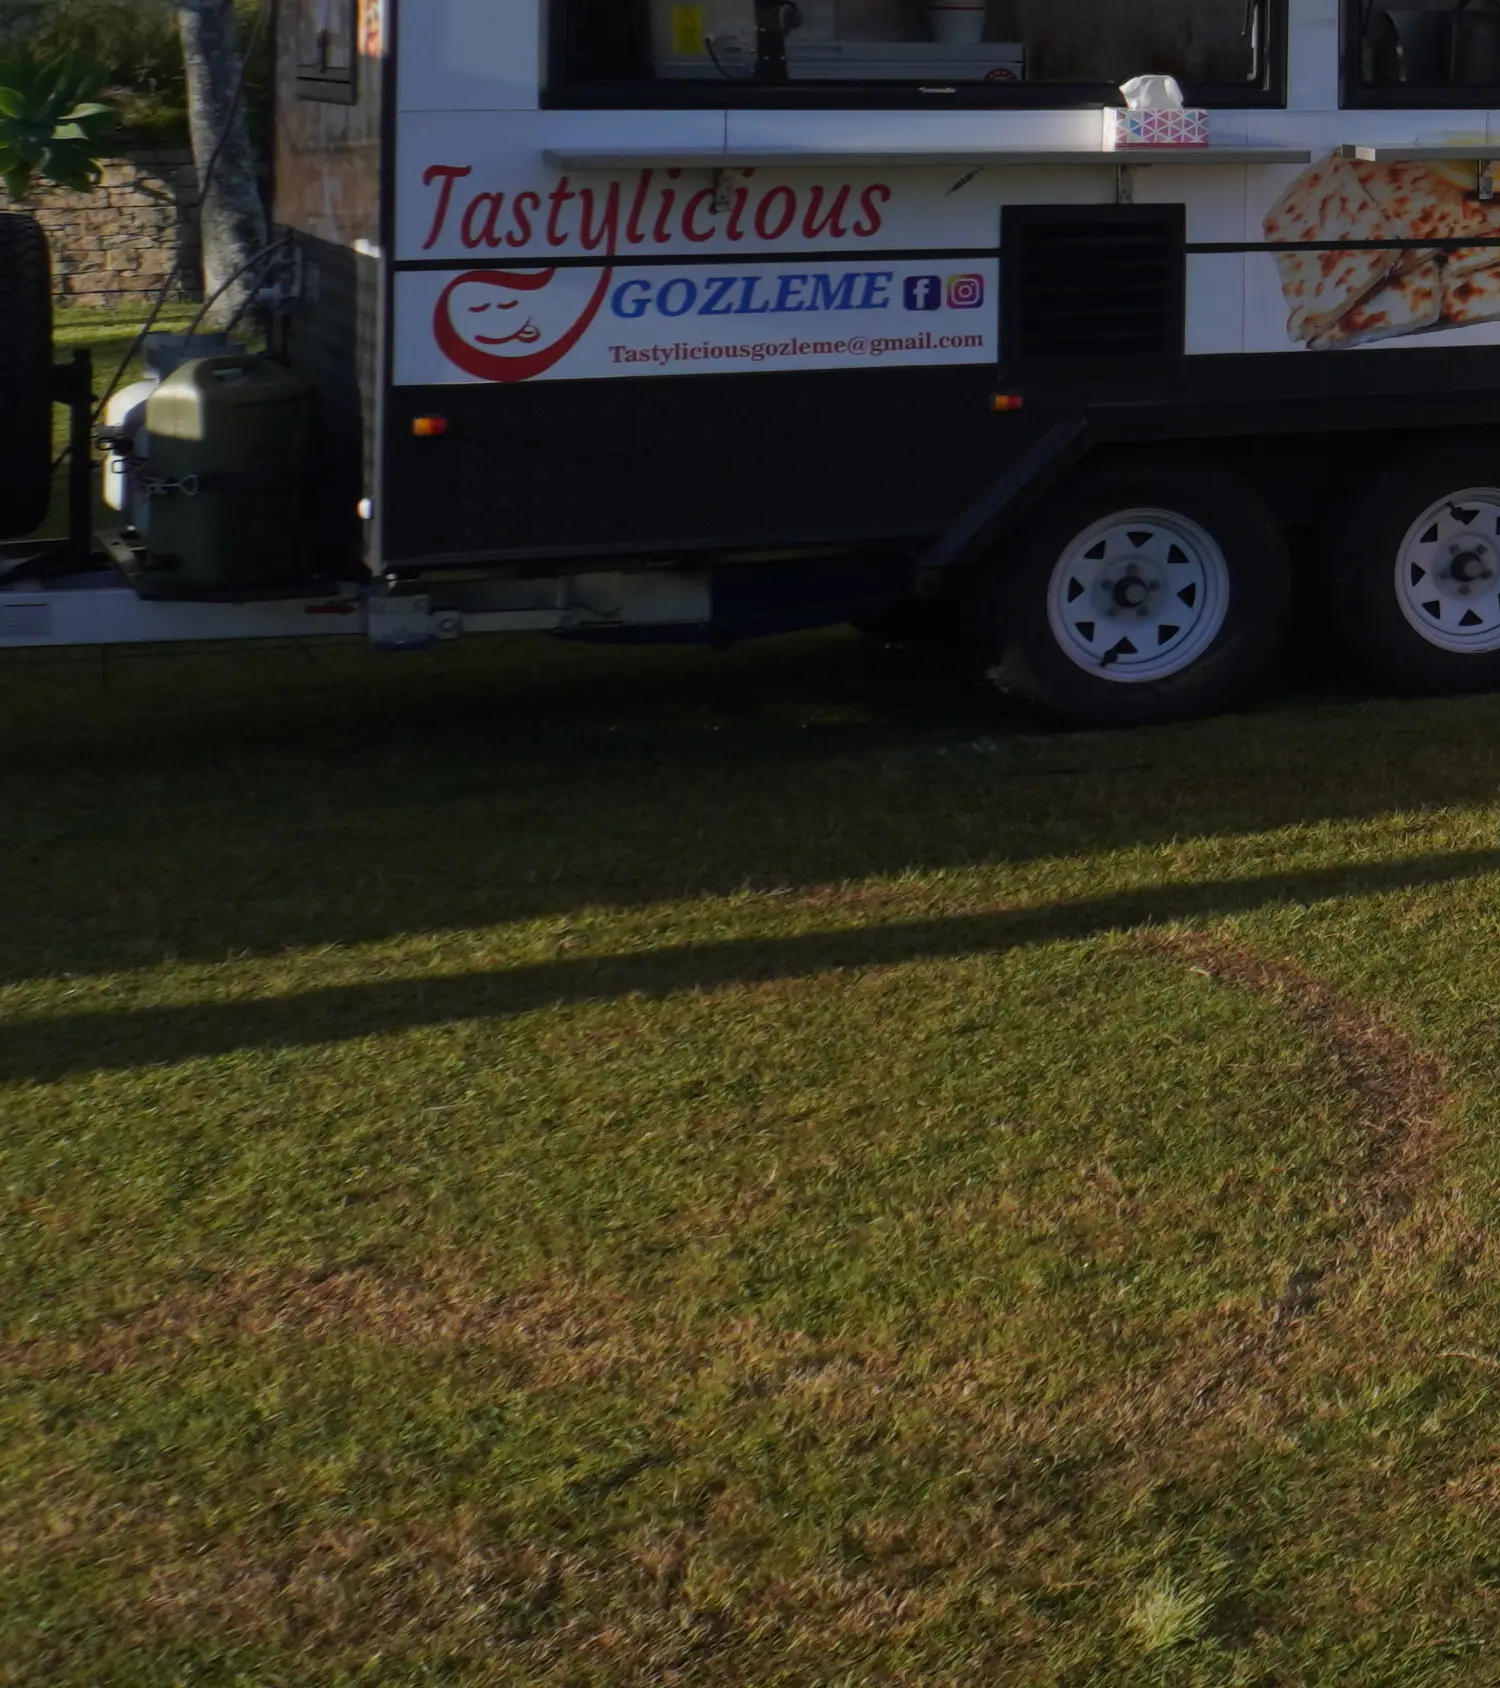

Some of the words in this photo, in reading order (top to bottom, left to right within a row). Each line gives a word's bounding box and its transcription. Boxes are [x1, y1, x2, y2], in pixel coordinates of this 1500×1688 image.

[421, 164, 892, 255] Tastylicious
[610, 271, 895, 319] GOZLEME
[609, 330, 984, 365] Tastyliciousgozleme@gmail.com
